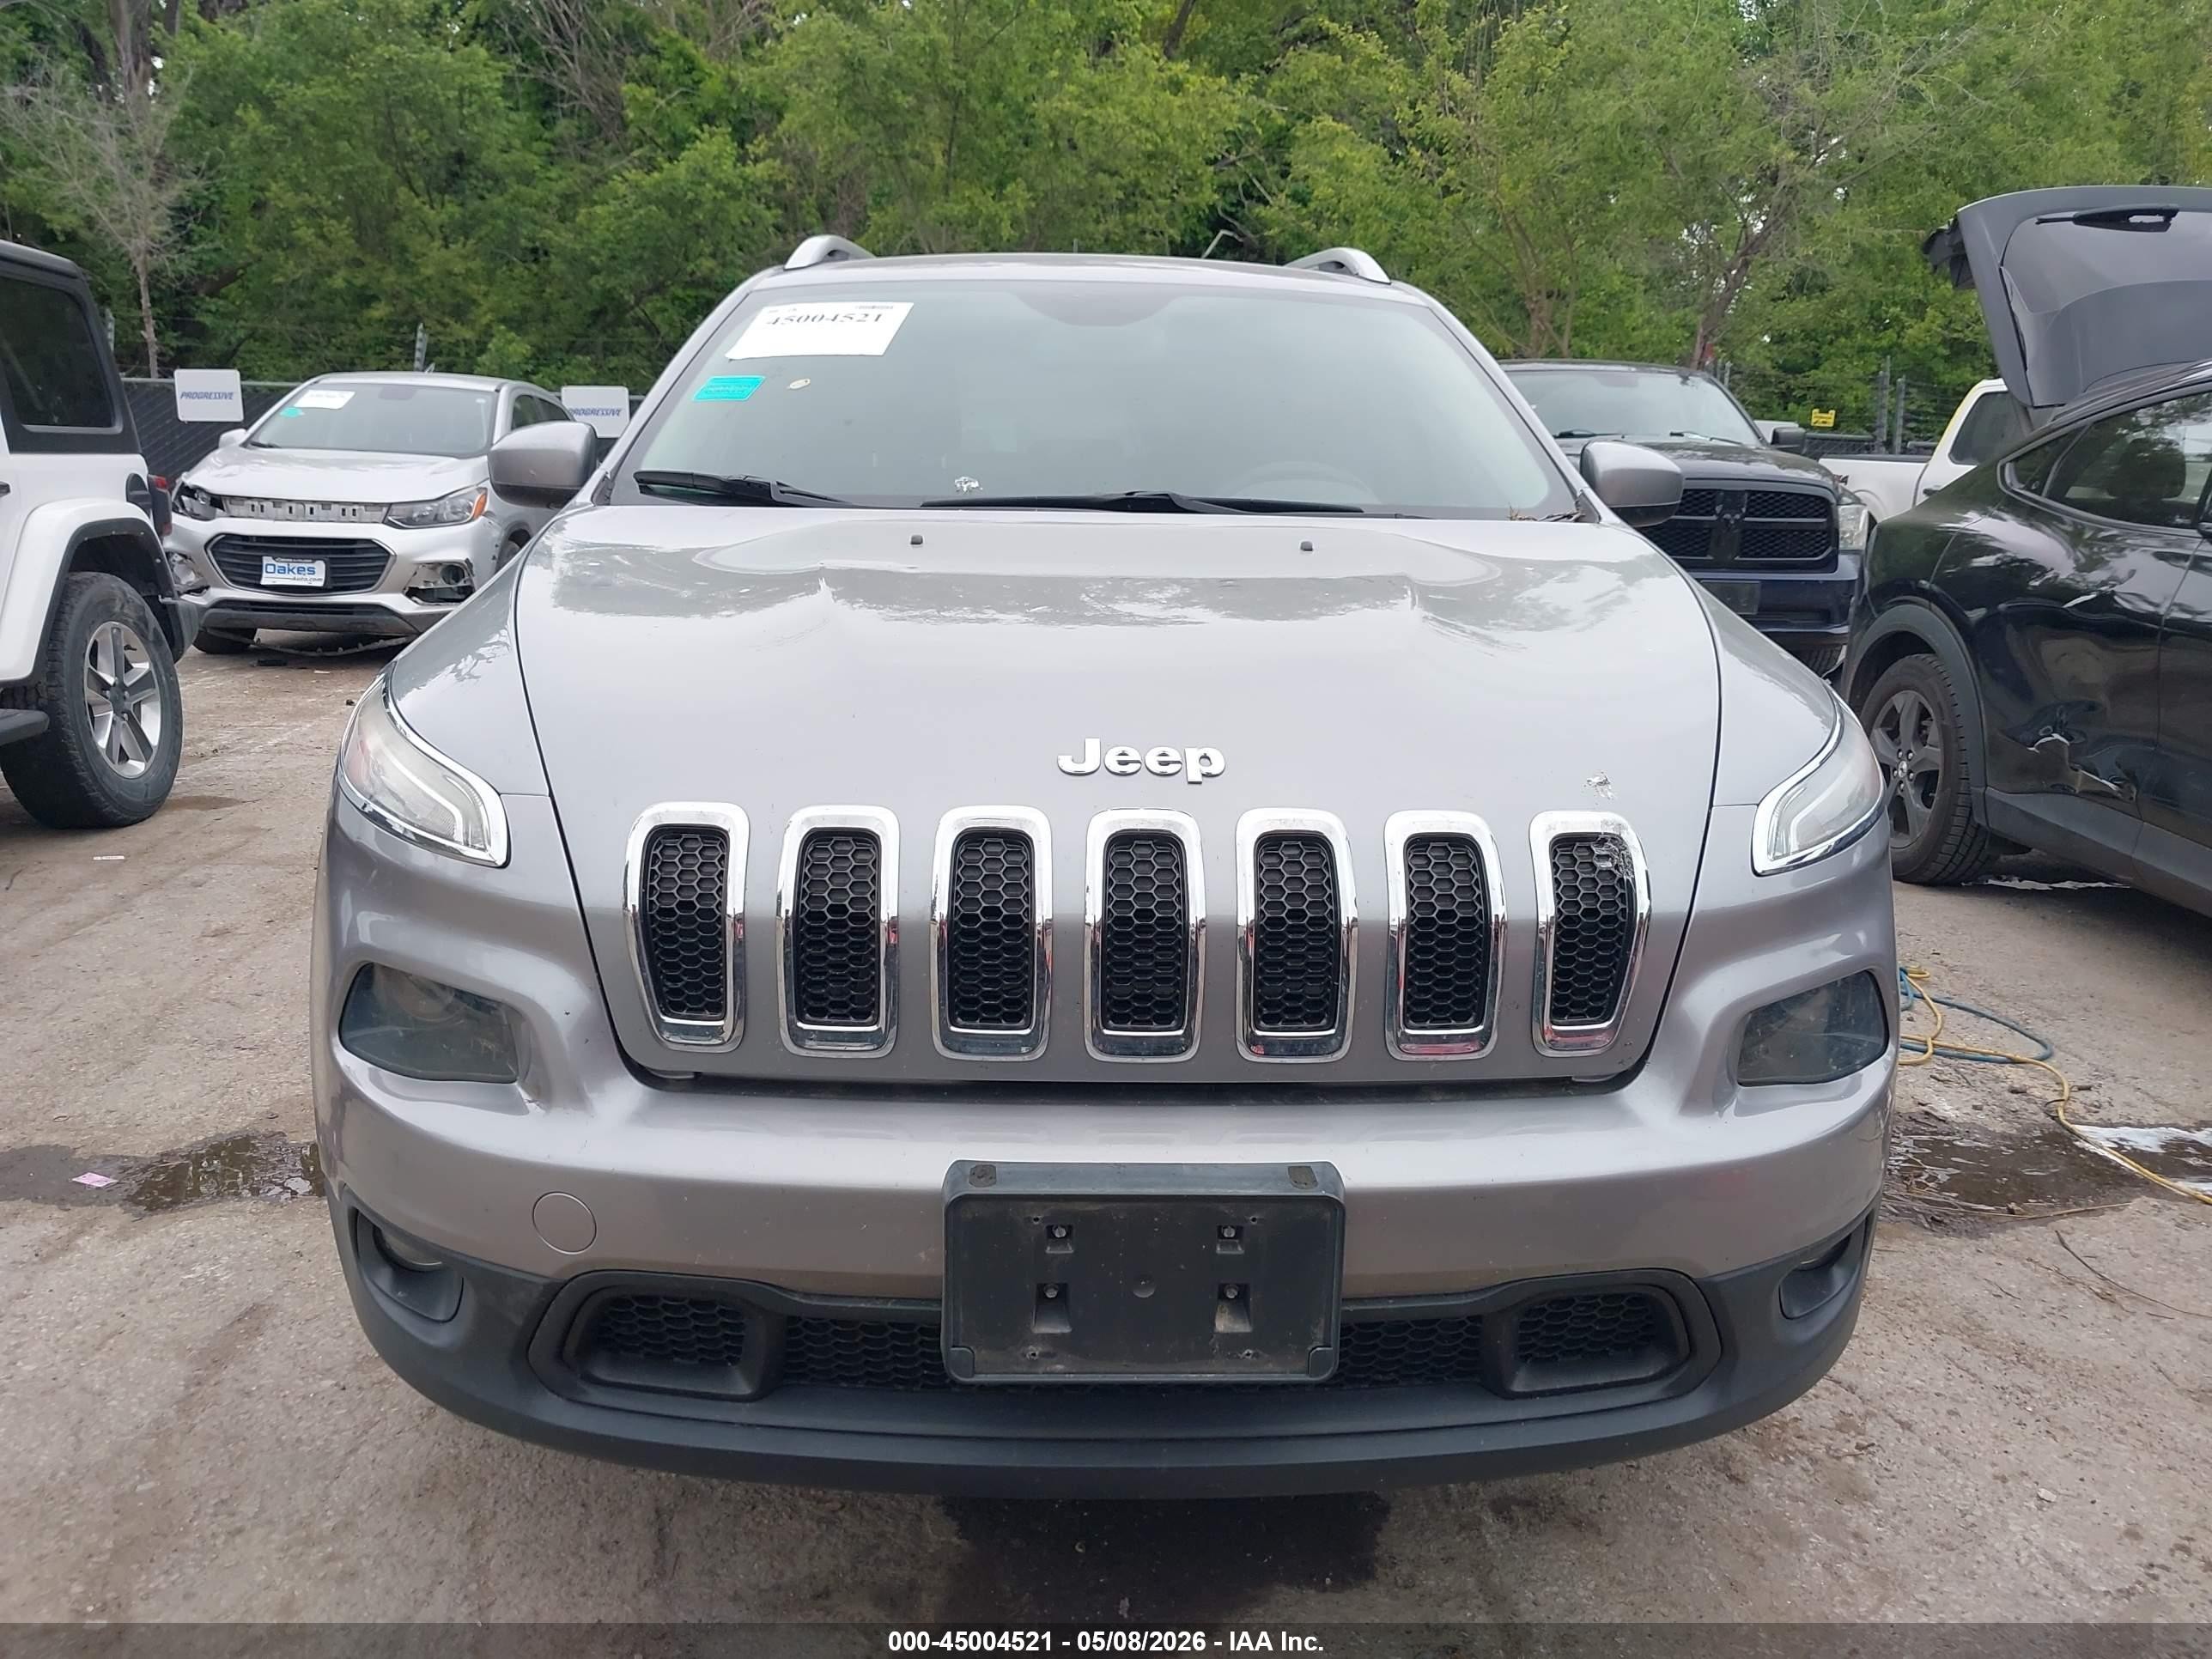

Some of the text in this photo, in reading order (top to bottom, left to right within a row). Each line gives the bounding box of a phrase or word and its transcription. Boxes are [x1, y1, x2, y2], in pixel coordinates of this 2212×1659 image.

[765, 313, 883, 325] 45004521
[180, 391, 234, 400] PROGRESSIVE
[264, 563, 317, 575] Oakes
[1057, 738, 1225, 785] Jeep
